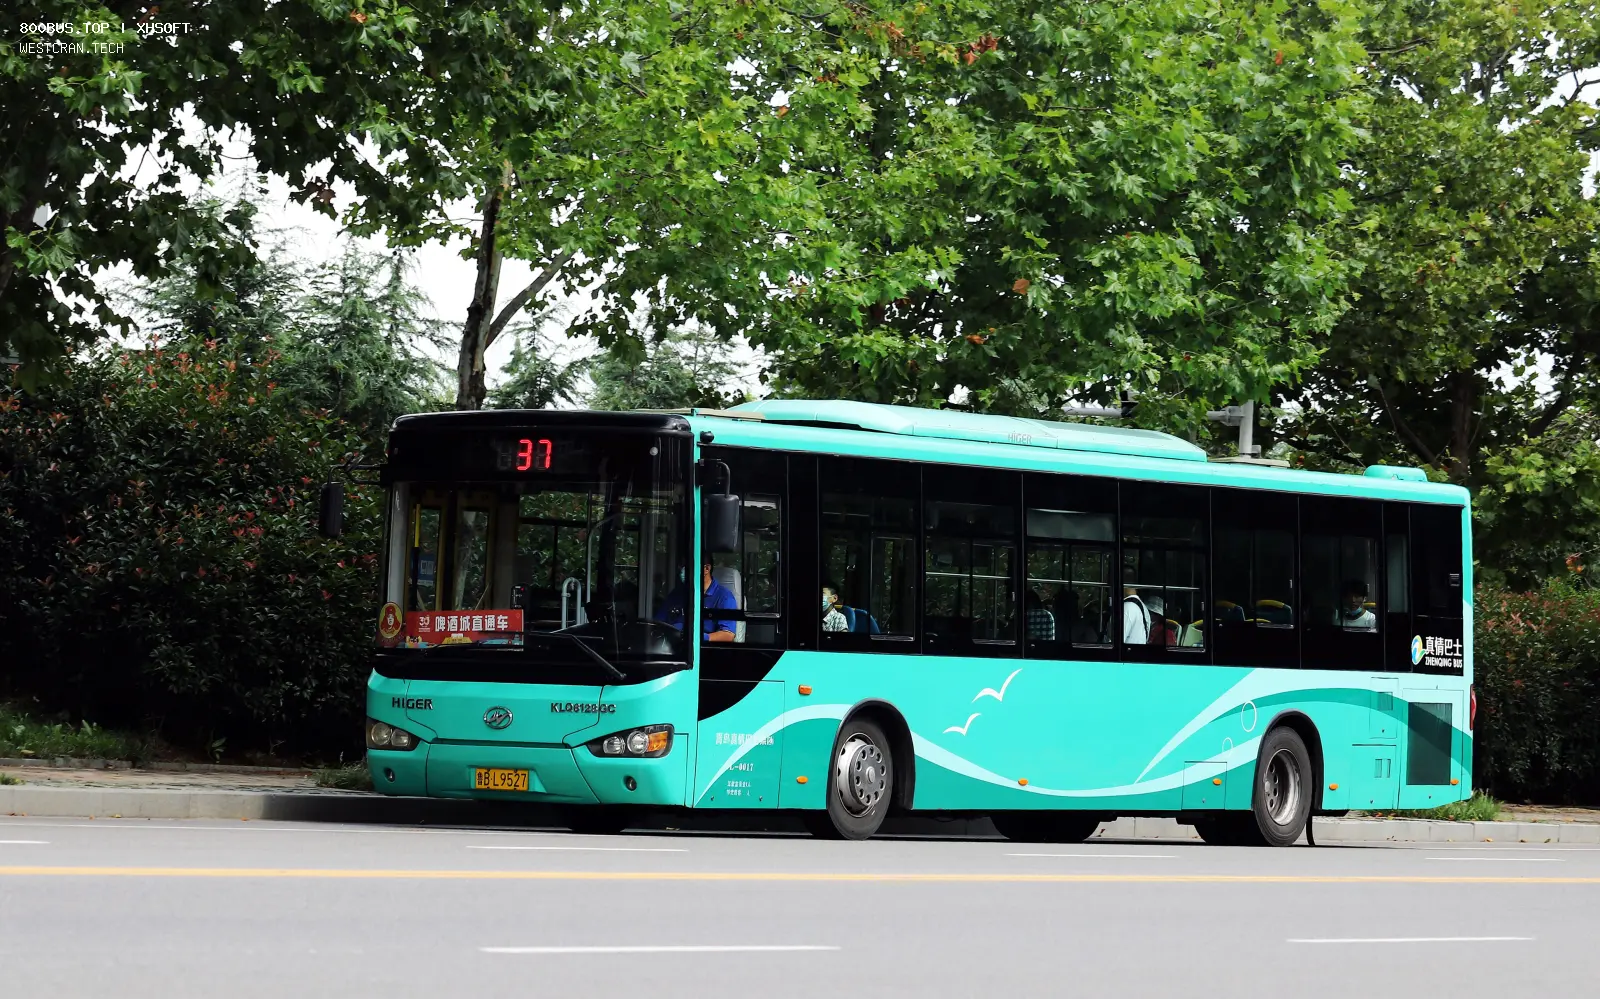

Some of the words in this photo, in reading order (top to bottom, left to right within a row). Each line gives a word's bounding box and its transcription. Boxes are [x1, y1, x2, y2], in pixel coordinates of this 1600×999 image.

[1008, 433, 1032, 445] HIGER
[517, 439, 552, 470] 37
[435, 615, 508, 632] 啤酒城直通车
[1425, 636, 1462, 656] 真情巴士
[1425, 656, 1452, 668] ZHENQING
[1453, 658, 1463, 668] BUS
[392, 697, 433, 710] HIGER
